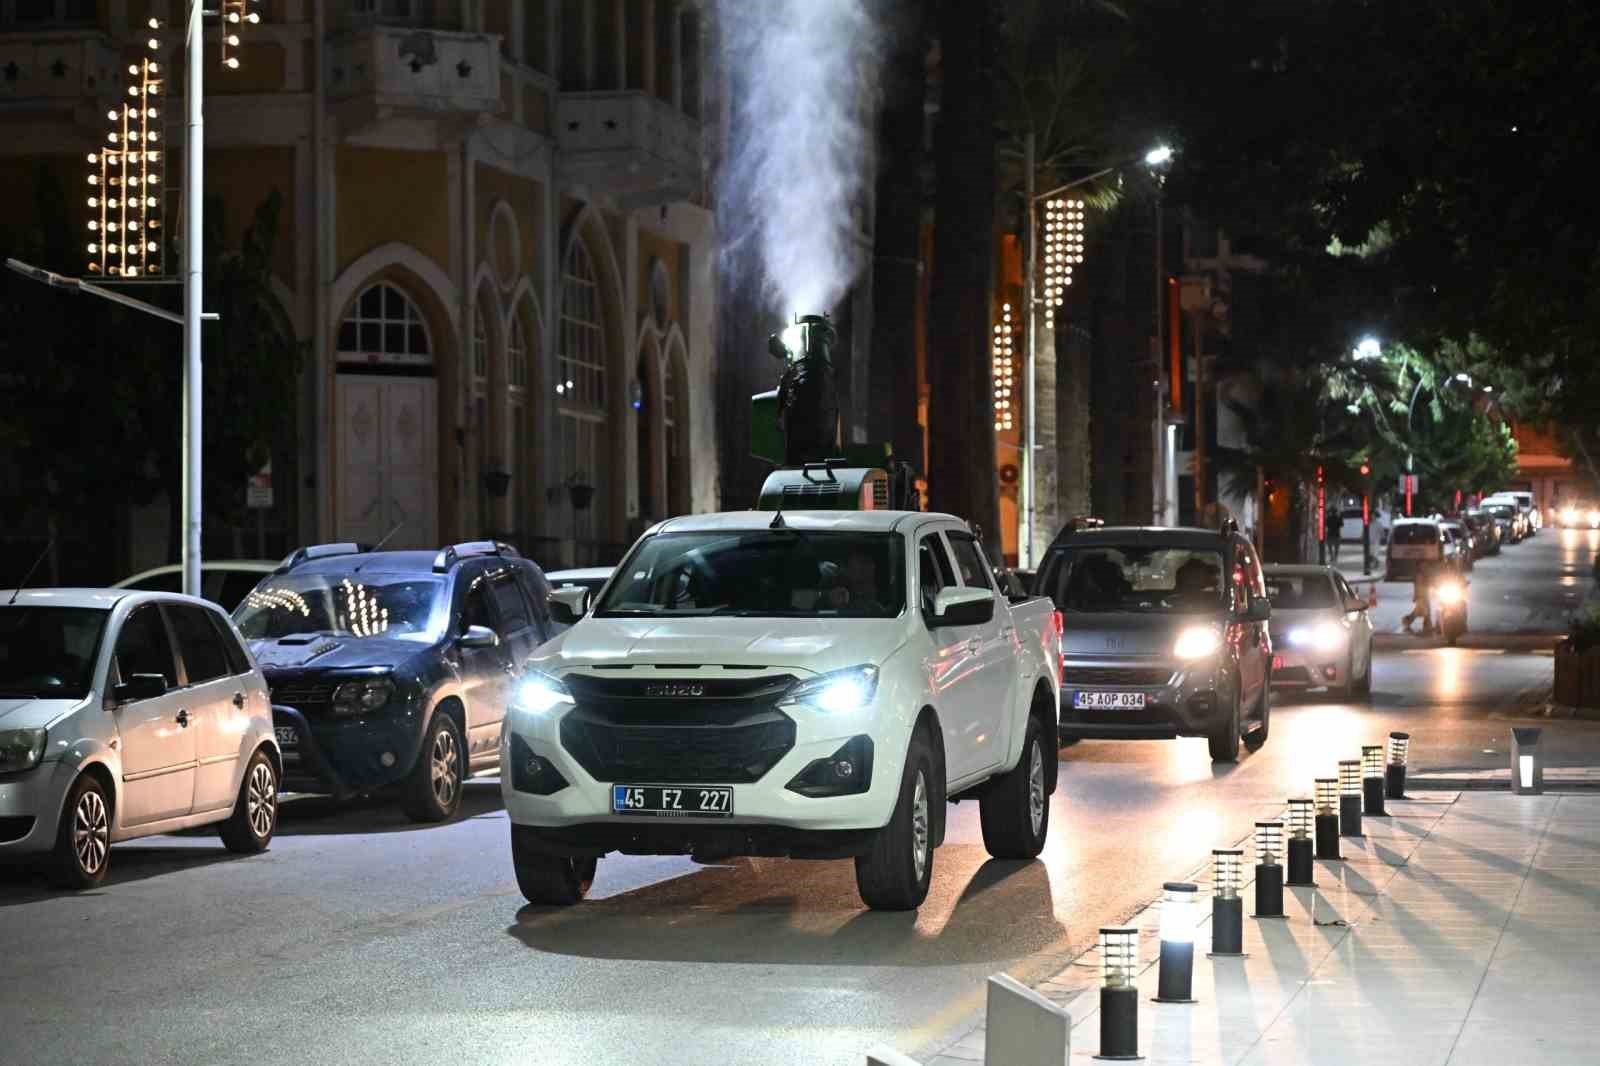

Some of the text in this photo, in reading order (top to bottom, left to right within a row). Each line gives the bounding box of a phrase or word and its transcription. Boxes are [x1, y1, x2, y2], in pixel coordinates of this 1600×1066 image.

[1080, 693, 1094, 705] 45
[1097, 693, 1118, 705] AOP
[1121, 694, 1143, 705] 034
[624, 788, 729, 810] 45 FZ 227
